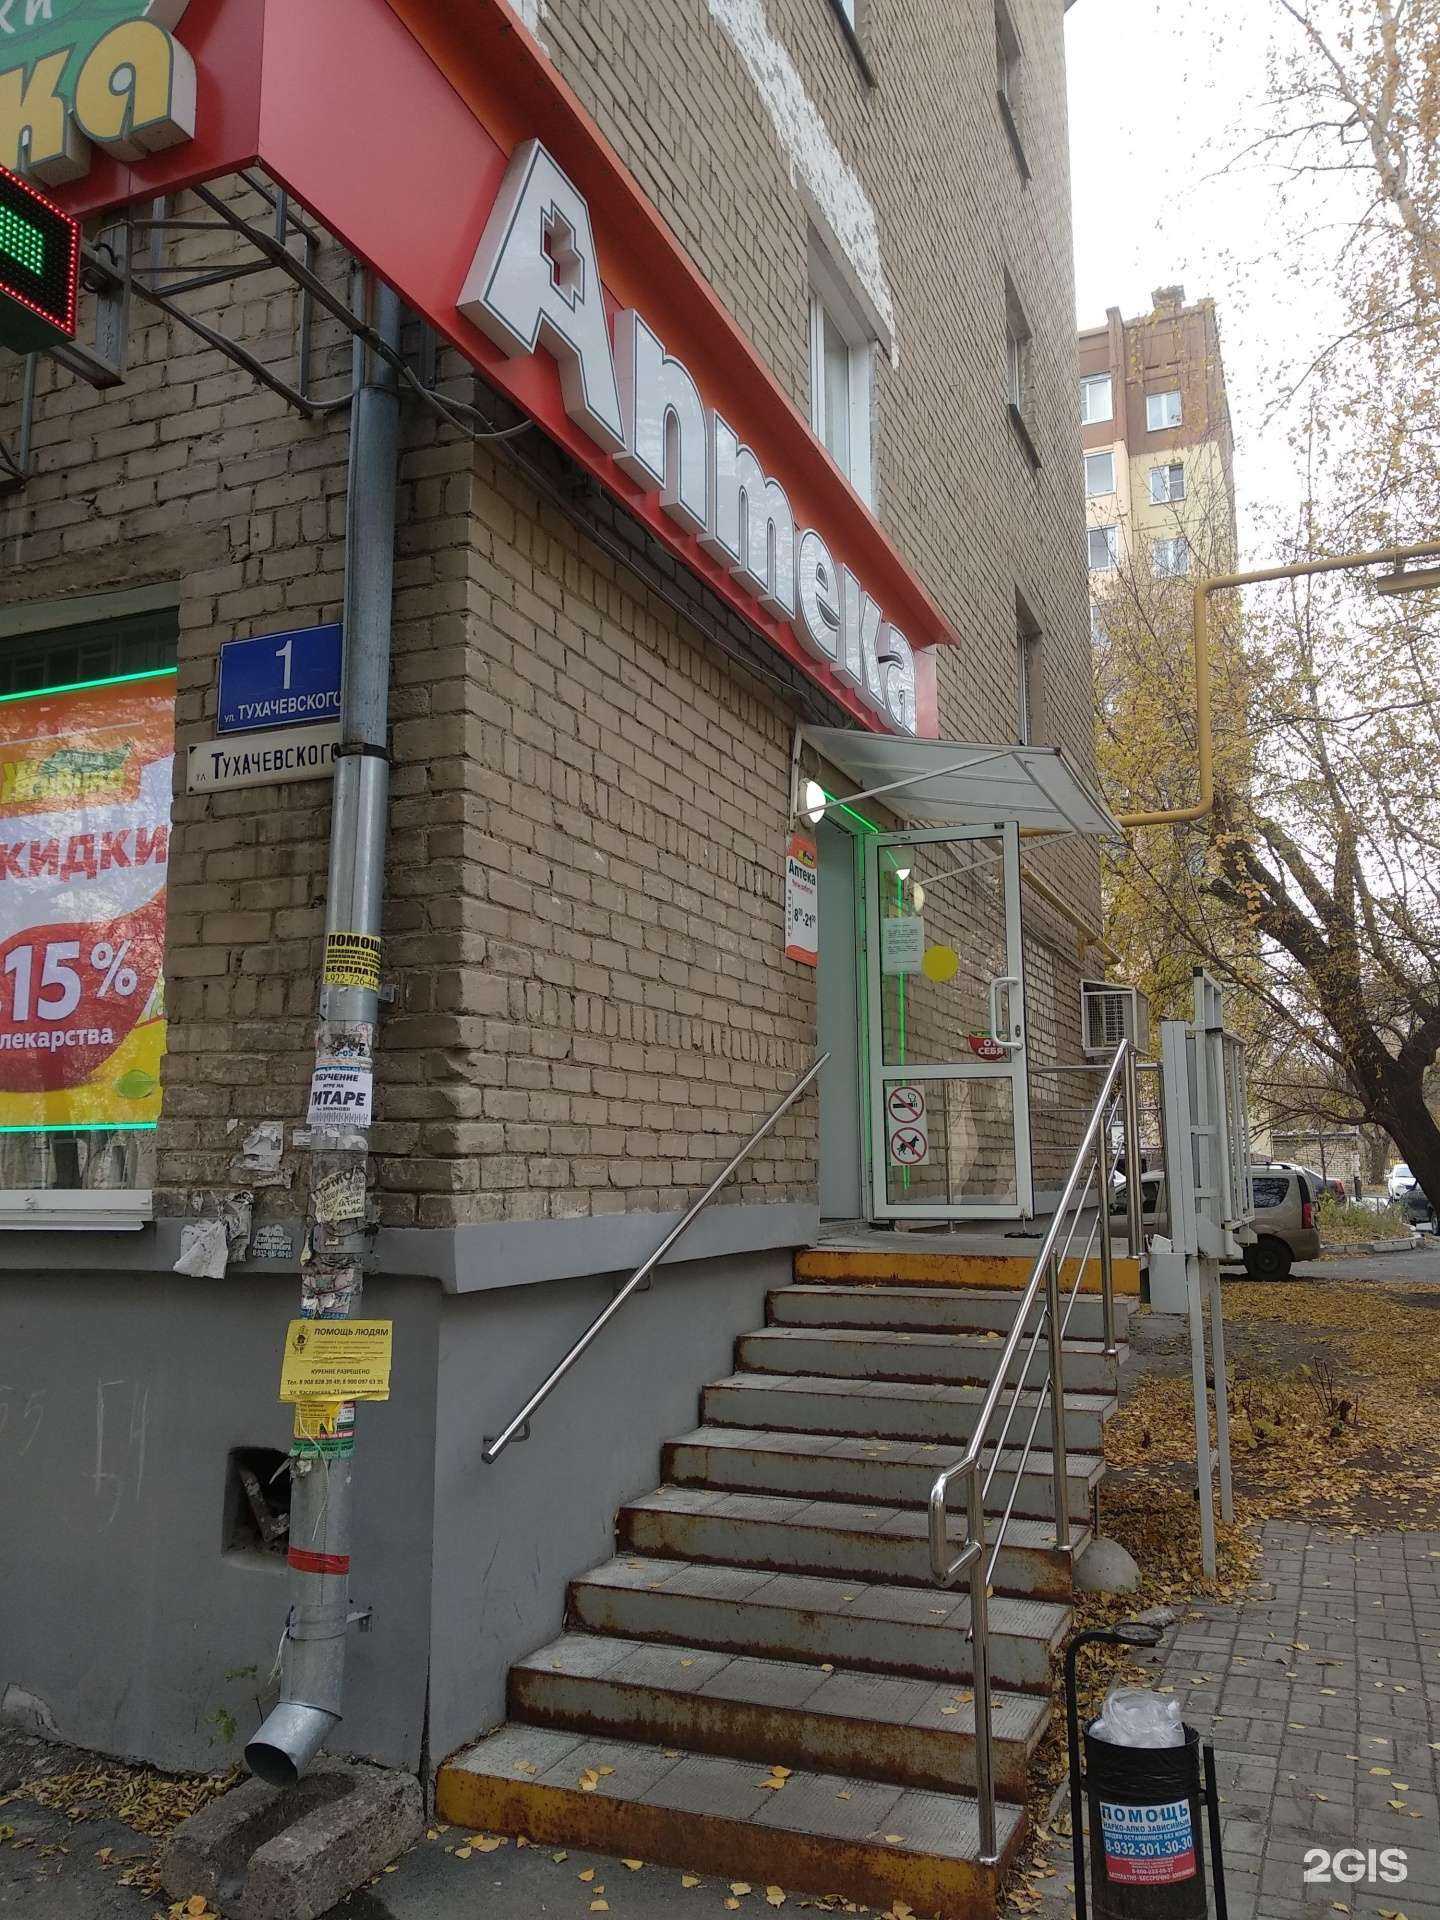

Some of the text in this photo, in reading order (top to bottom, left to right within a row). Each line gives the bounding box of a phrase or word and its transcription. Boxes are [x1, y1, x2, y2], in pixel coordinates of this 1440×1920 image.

[457, 137, 918, 740] Аптека
[275, 639, 293, 690] 1
[789, 859, 816, 886] Аптека
[328, 934, 381, 953] ПОМОЩ
[325, 965, 378, 979] БЕСПЛАТН
[978, 1047, 1004, 1055] СЕБЯ
[314, 1328, 389, 1337] ПОМОЩЬ ЛЮДЯМ
[1102, 1804, 1188, 1823] ПОМОЩЬ
[1105, 1835, 1193, 1856] 8-932-301-30-30
